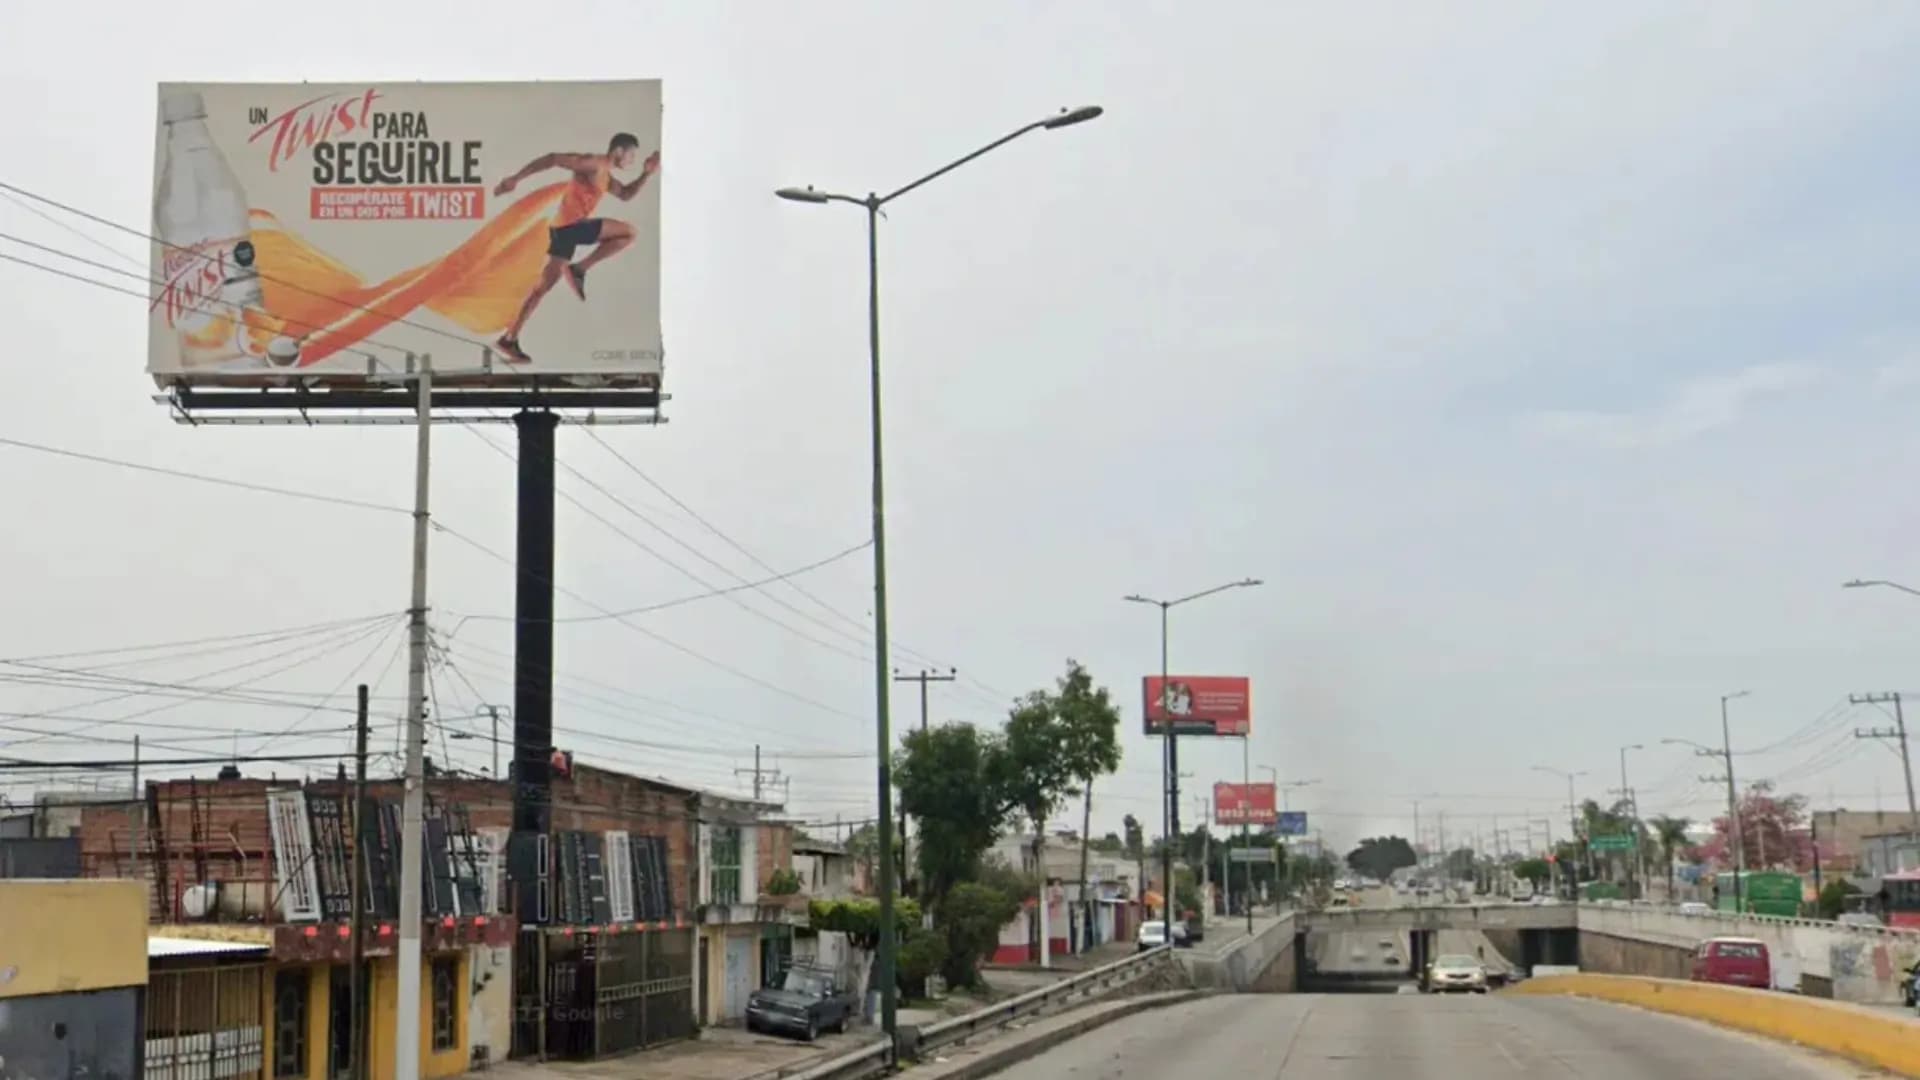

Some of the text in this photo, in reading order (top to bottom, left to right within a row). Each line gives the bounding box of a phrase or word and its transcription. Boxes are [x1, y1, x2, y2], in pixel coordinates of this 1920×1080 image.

[248, 88, 429, 172] UN Twist PARA
[319, 188, 405, 205] RECUPÉRATE
[319, 205, 406, 217] EN UN DOS POR
